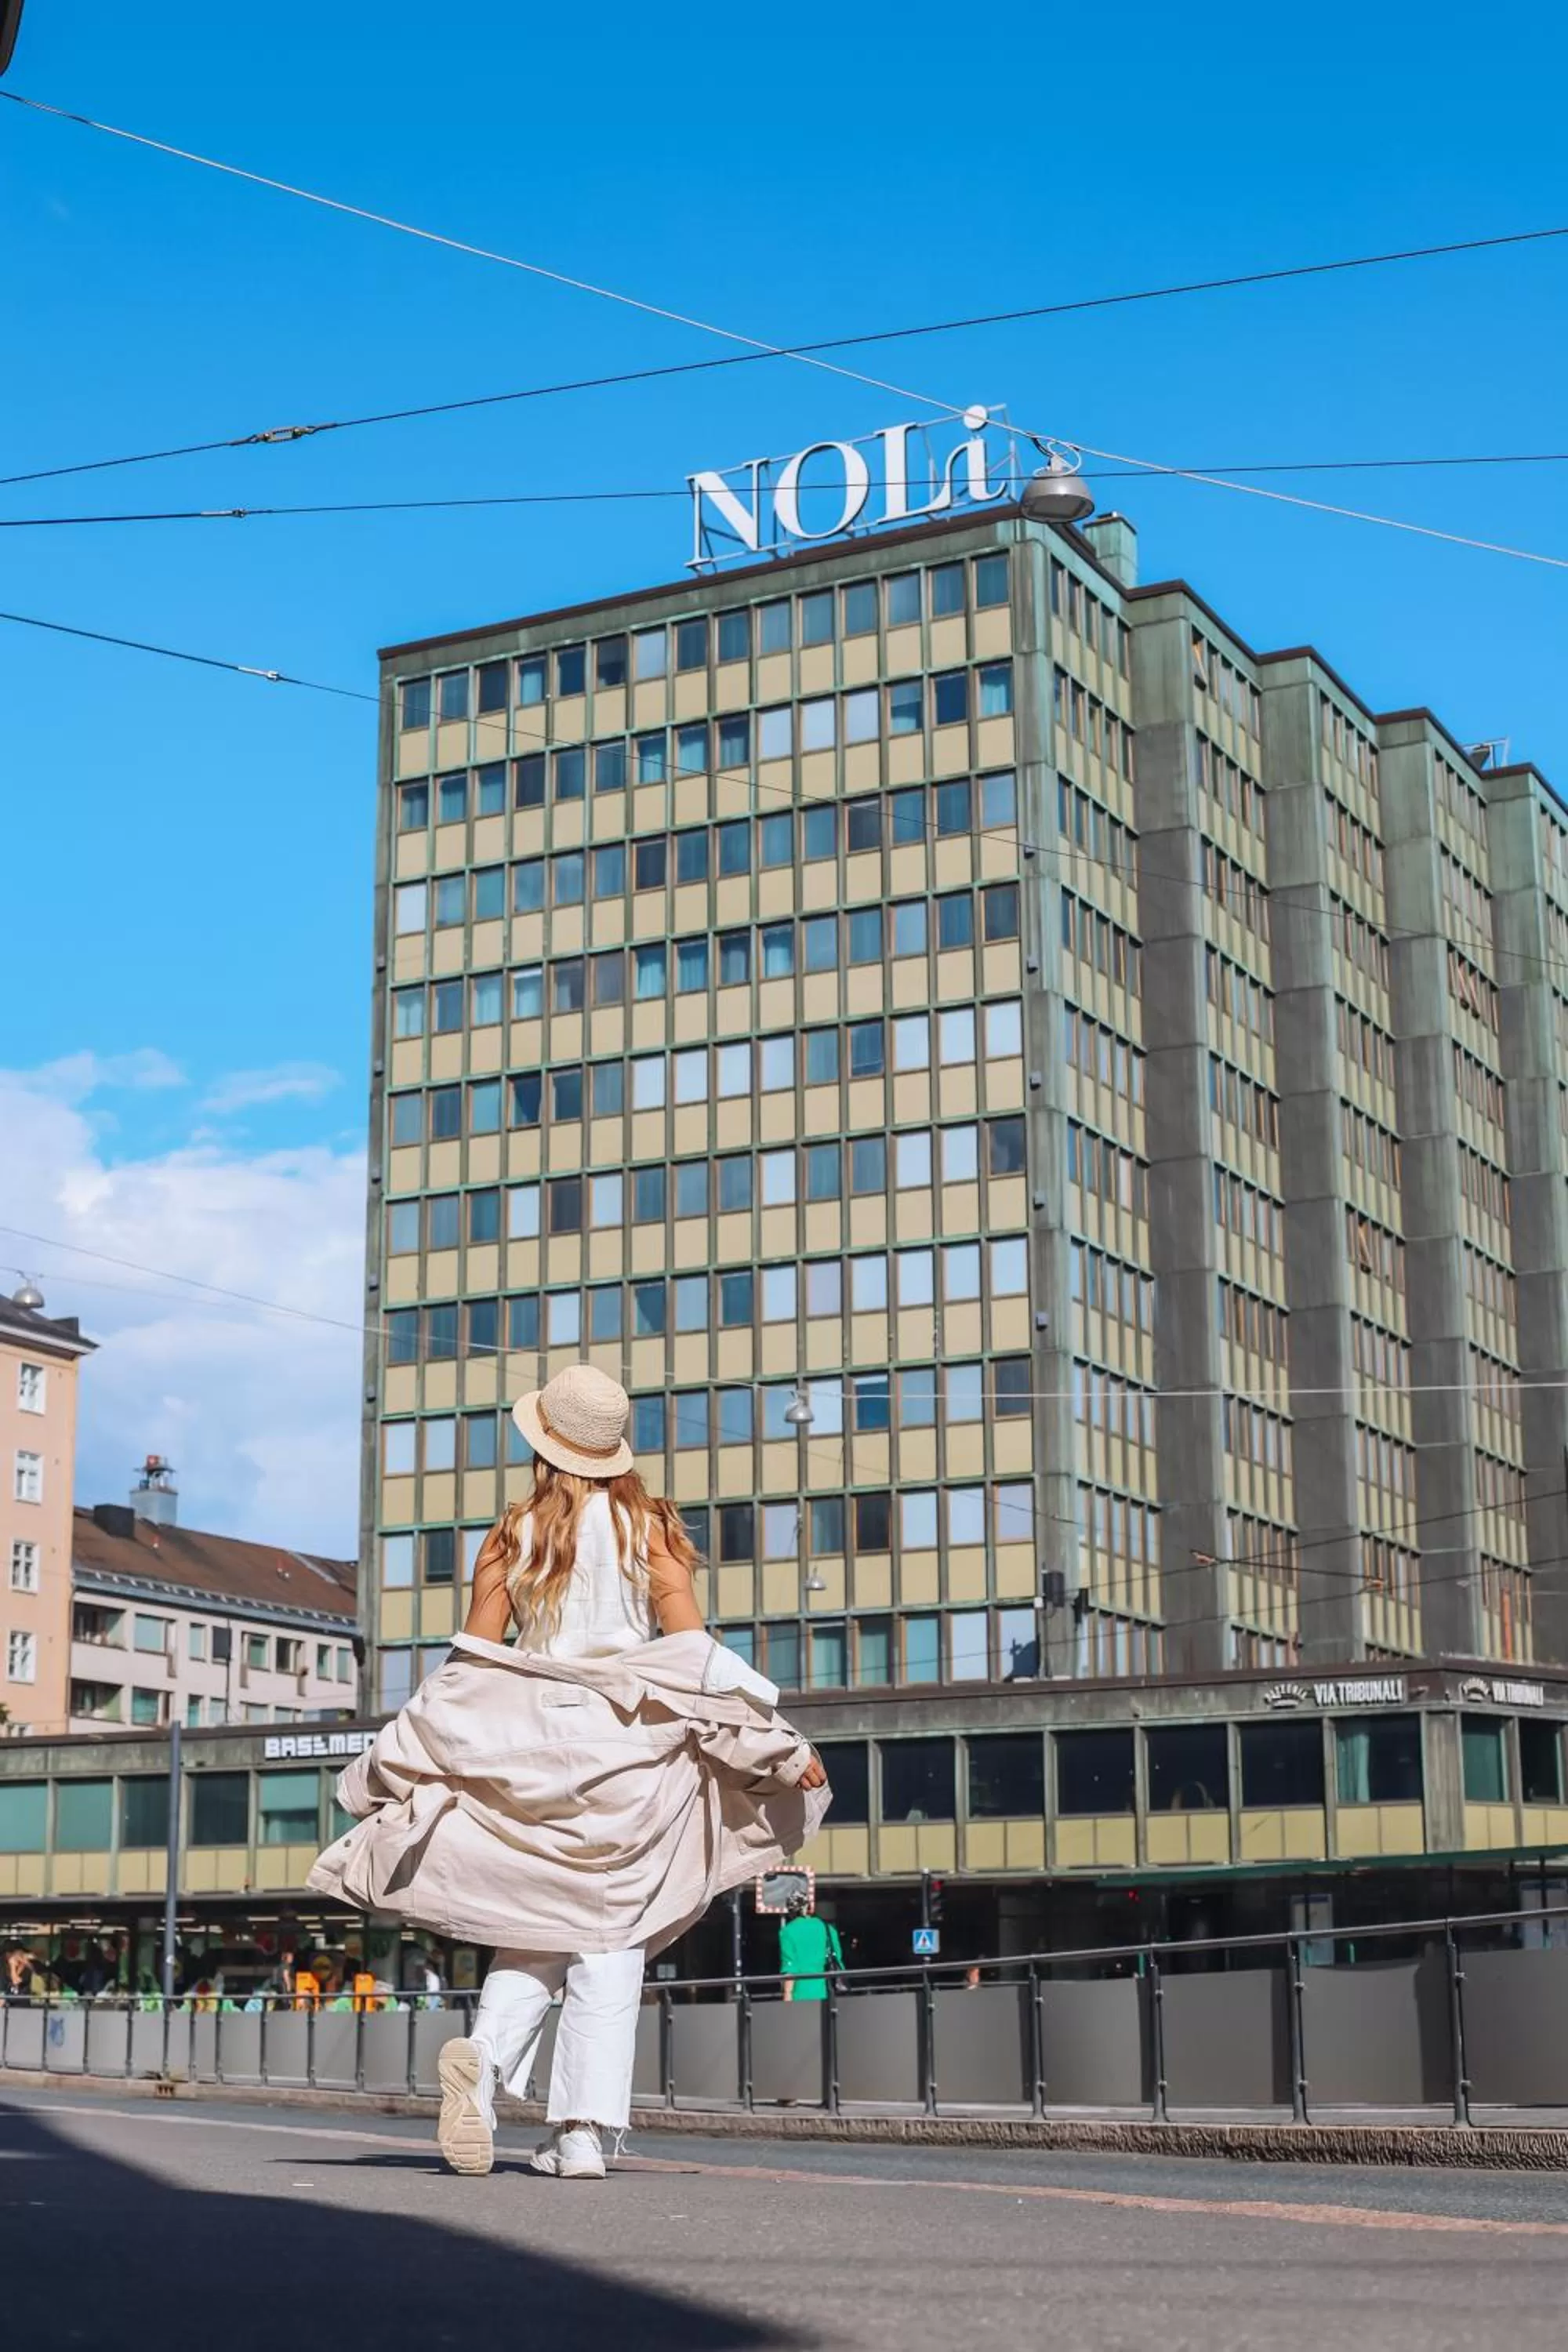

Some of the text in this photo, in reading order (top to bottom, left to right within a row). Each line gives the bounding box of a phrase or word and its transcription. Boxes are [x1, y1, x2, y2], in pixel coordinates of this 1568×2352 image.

[684, 405, 1007, 567] NOLi
[1314, 1679, 1402, 1704] VIA TRIBUNALI
